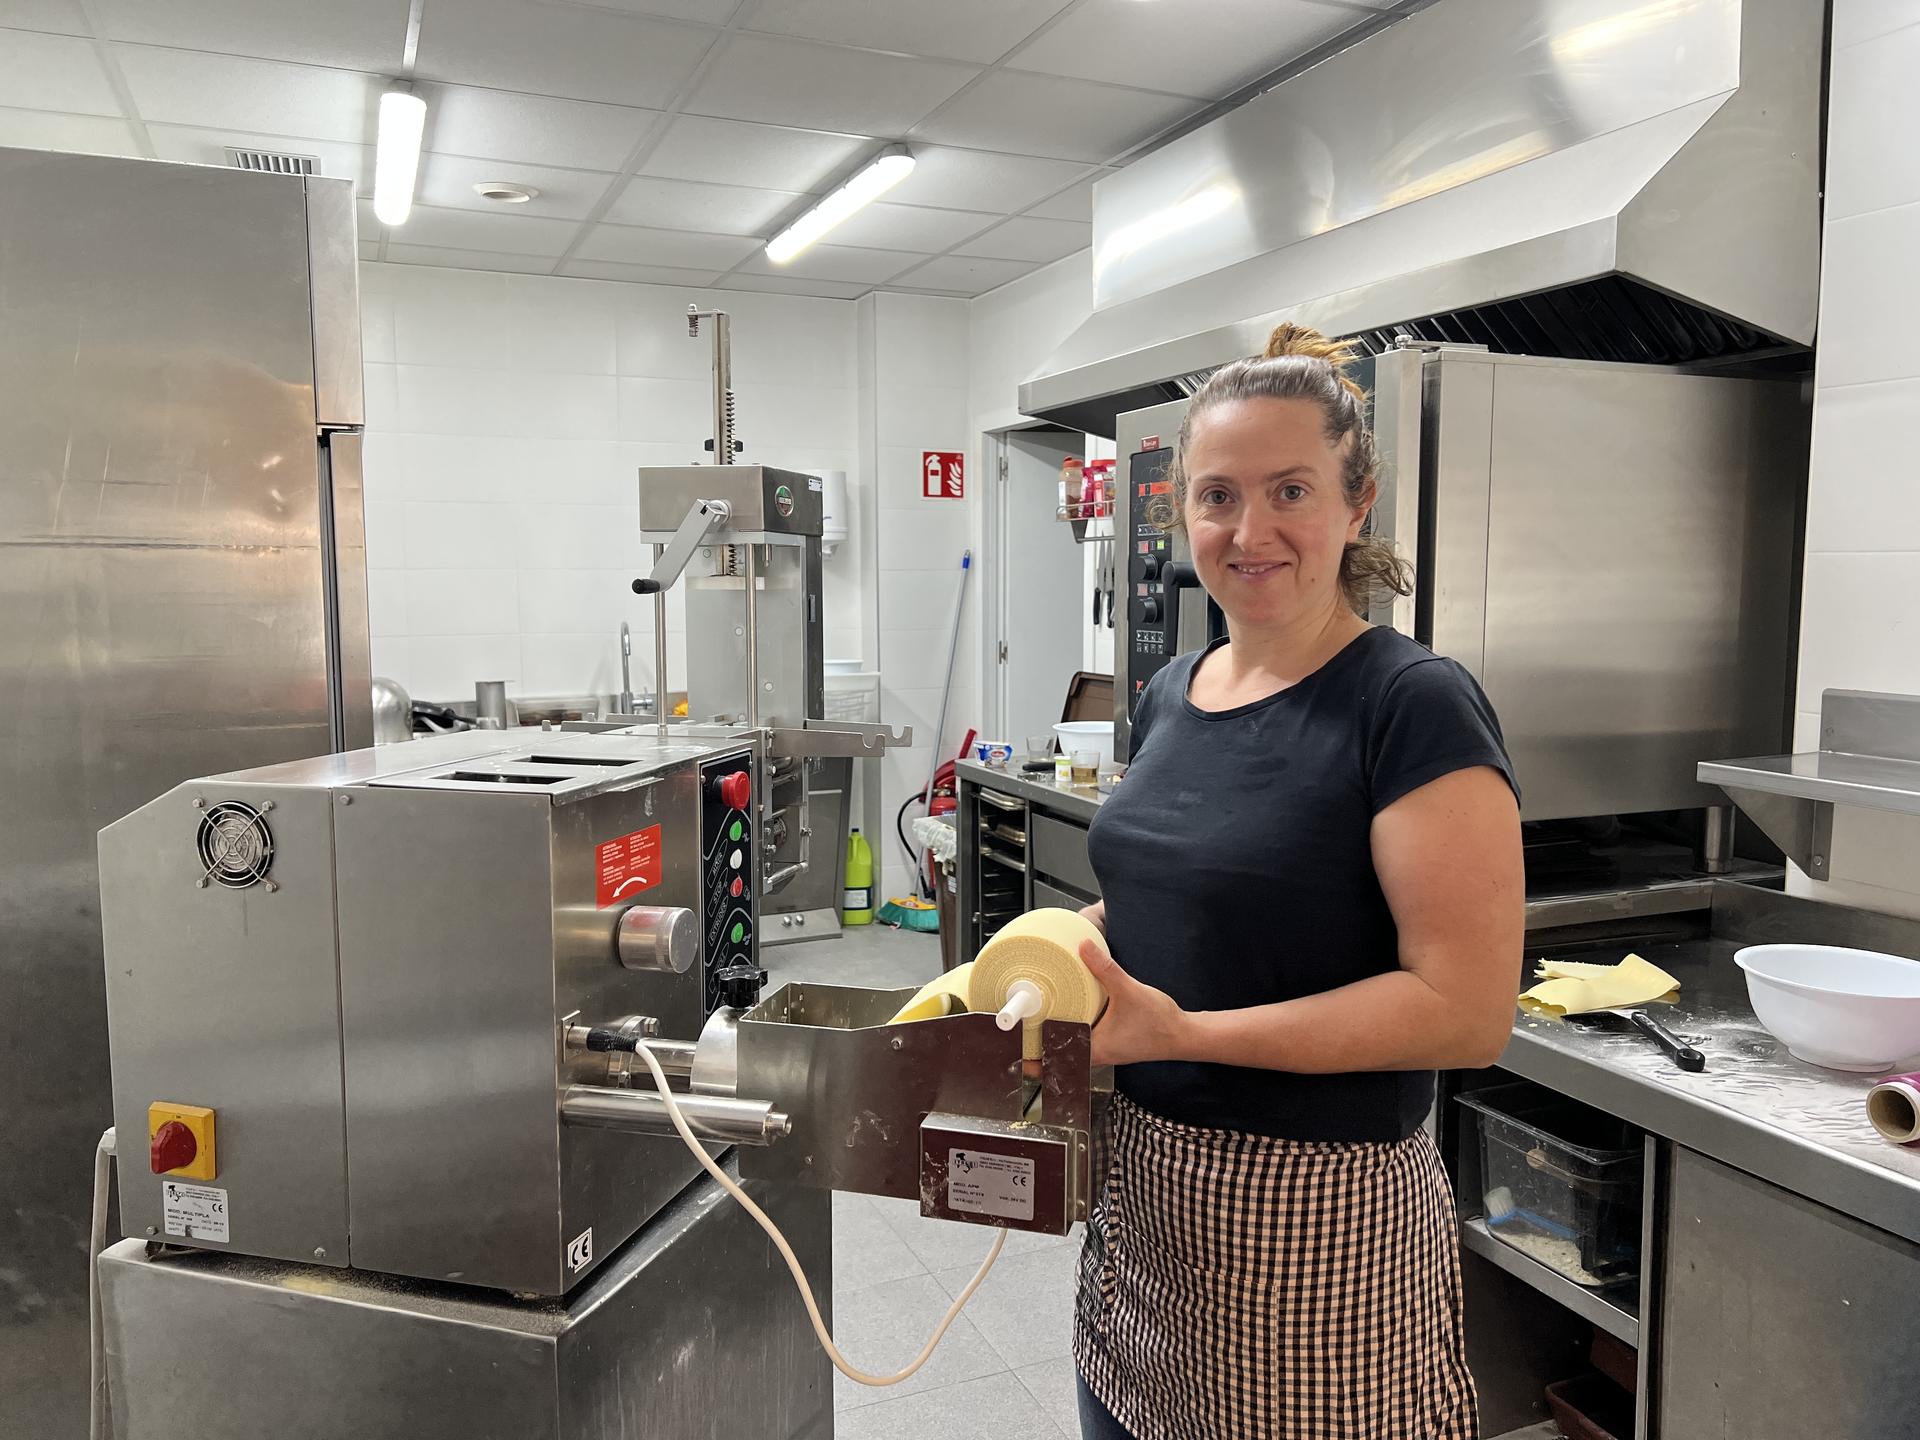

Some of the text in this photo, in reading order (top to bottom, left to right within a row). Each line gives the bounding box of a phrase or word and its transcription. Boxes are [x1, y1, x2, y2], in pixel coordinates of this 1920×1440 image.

[1012, 1175, 1027, 1187] CE
[211, 1203, 224, 1214] CE
[571, 1235, 589, 1266] CE
